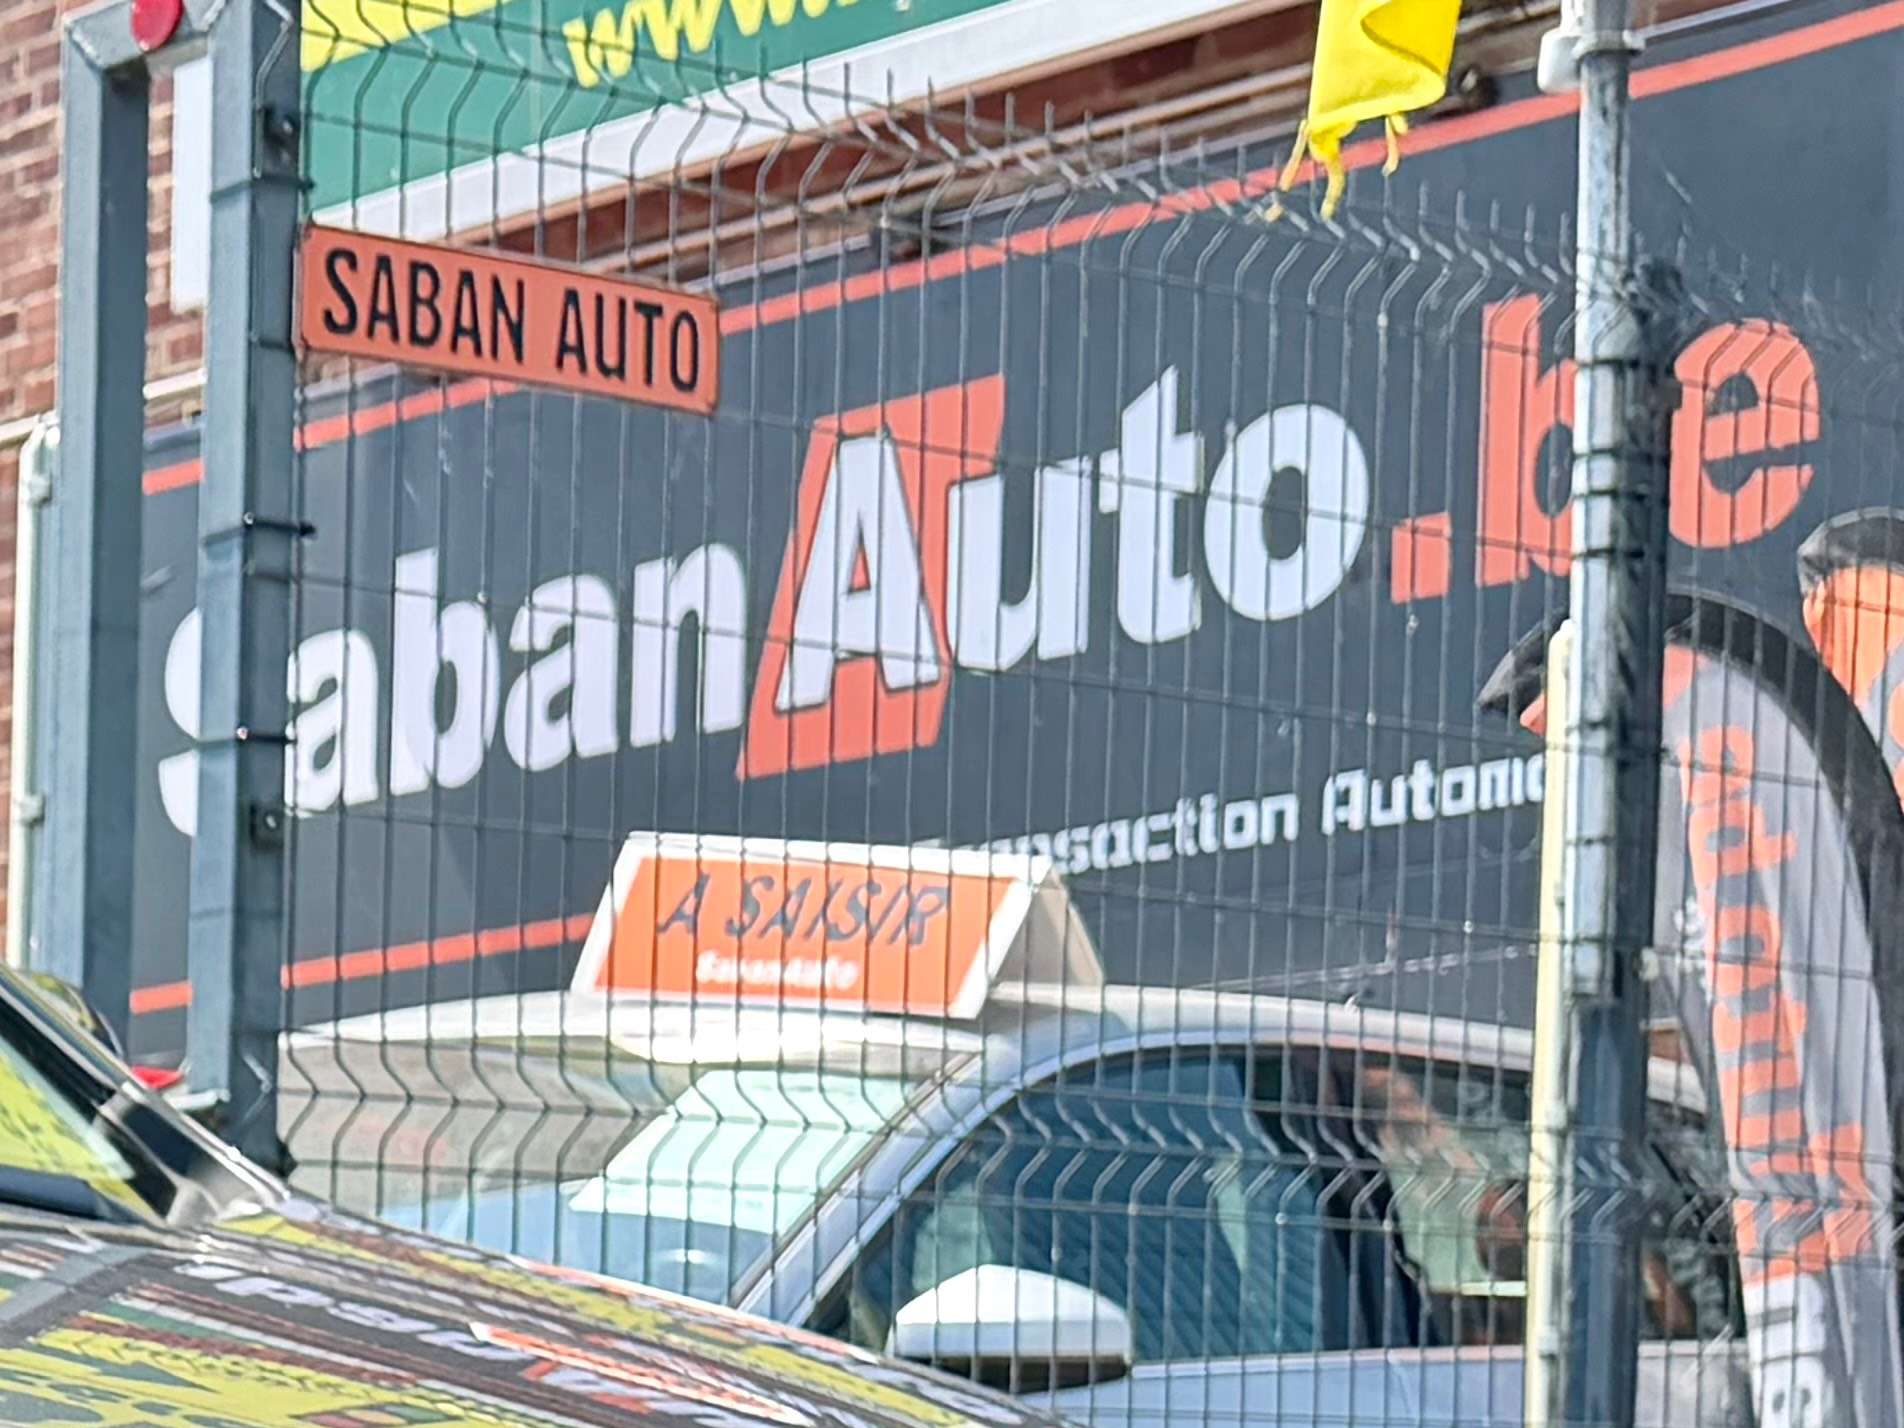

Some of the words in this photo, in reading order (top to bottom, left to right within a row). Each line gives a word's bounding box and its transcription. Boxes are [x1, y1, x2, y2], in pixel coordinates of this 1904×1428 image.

[323, 247, 525, 365] SABAN
[555, 289, 701, 393] AUTO
[657, 872, 711, 936] A
[727, 874, 949, 947] SAISIR
